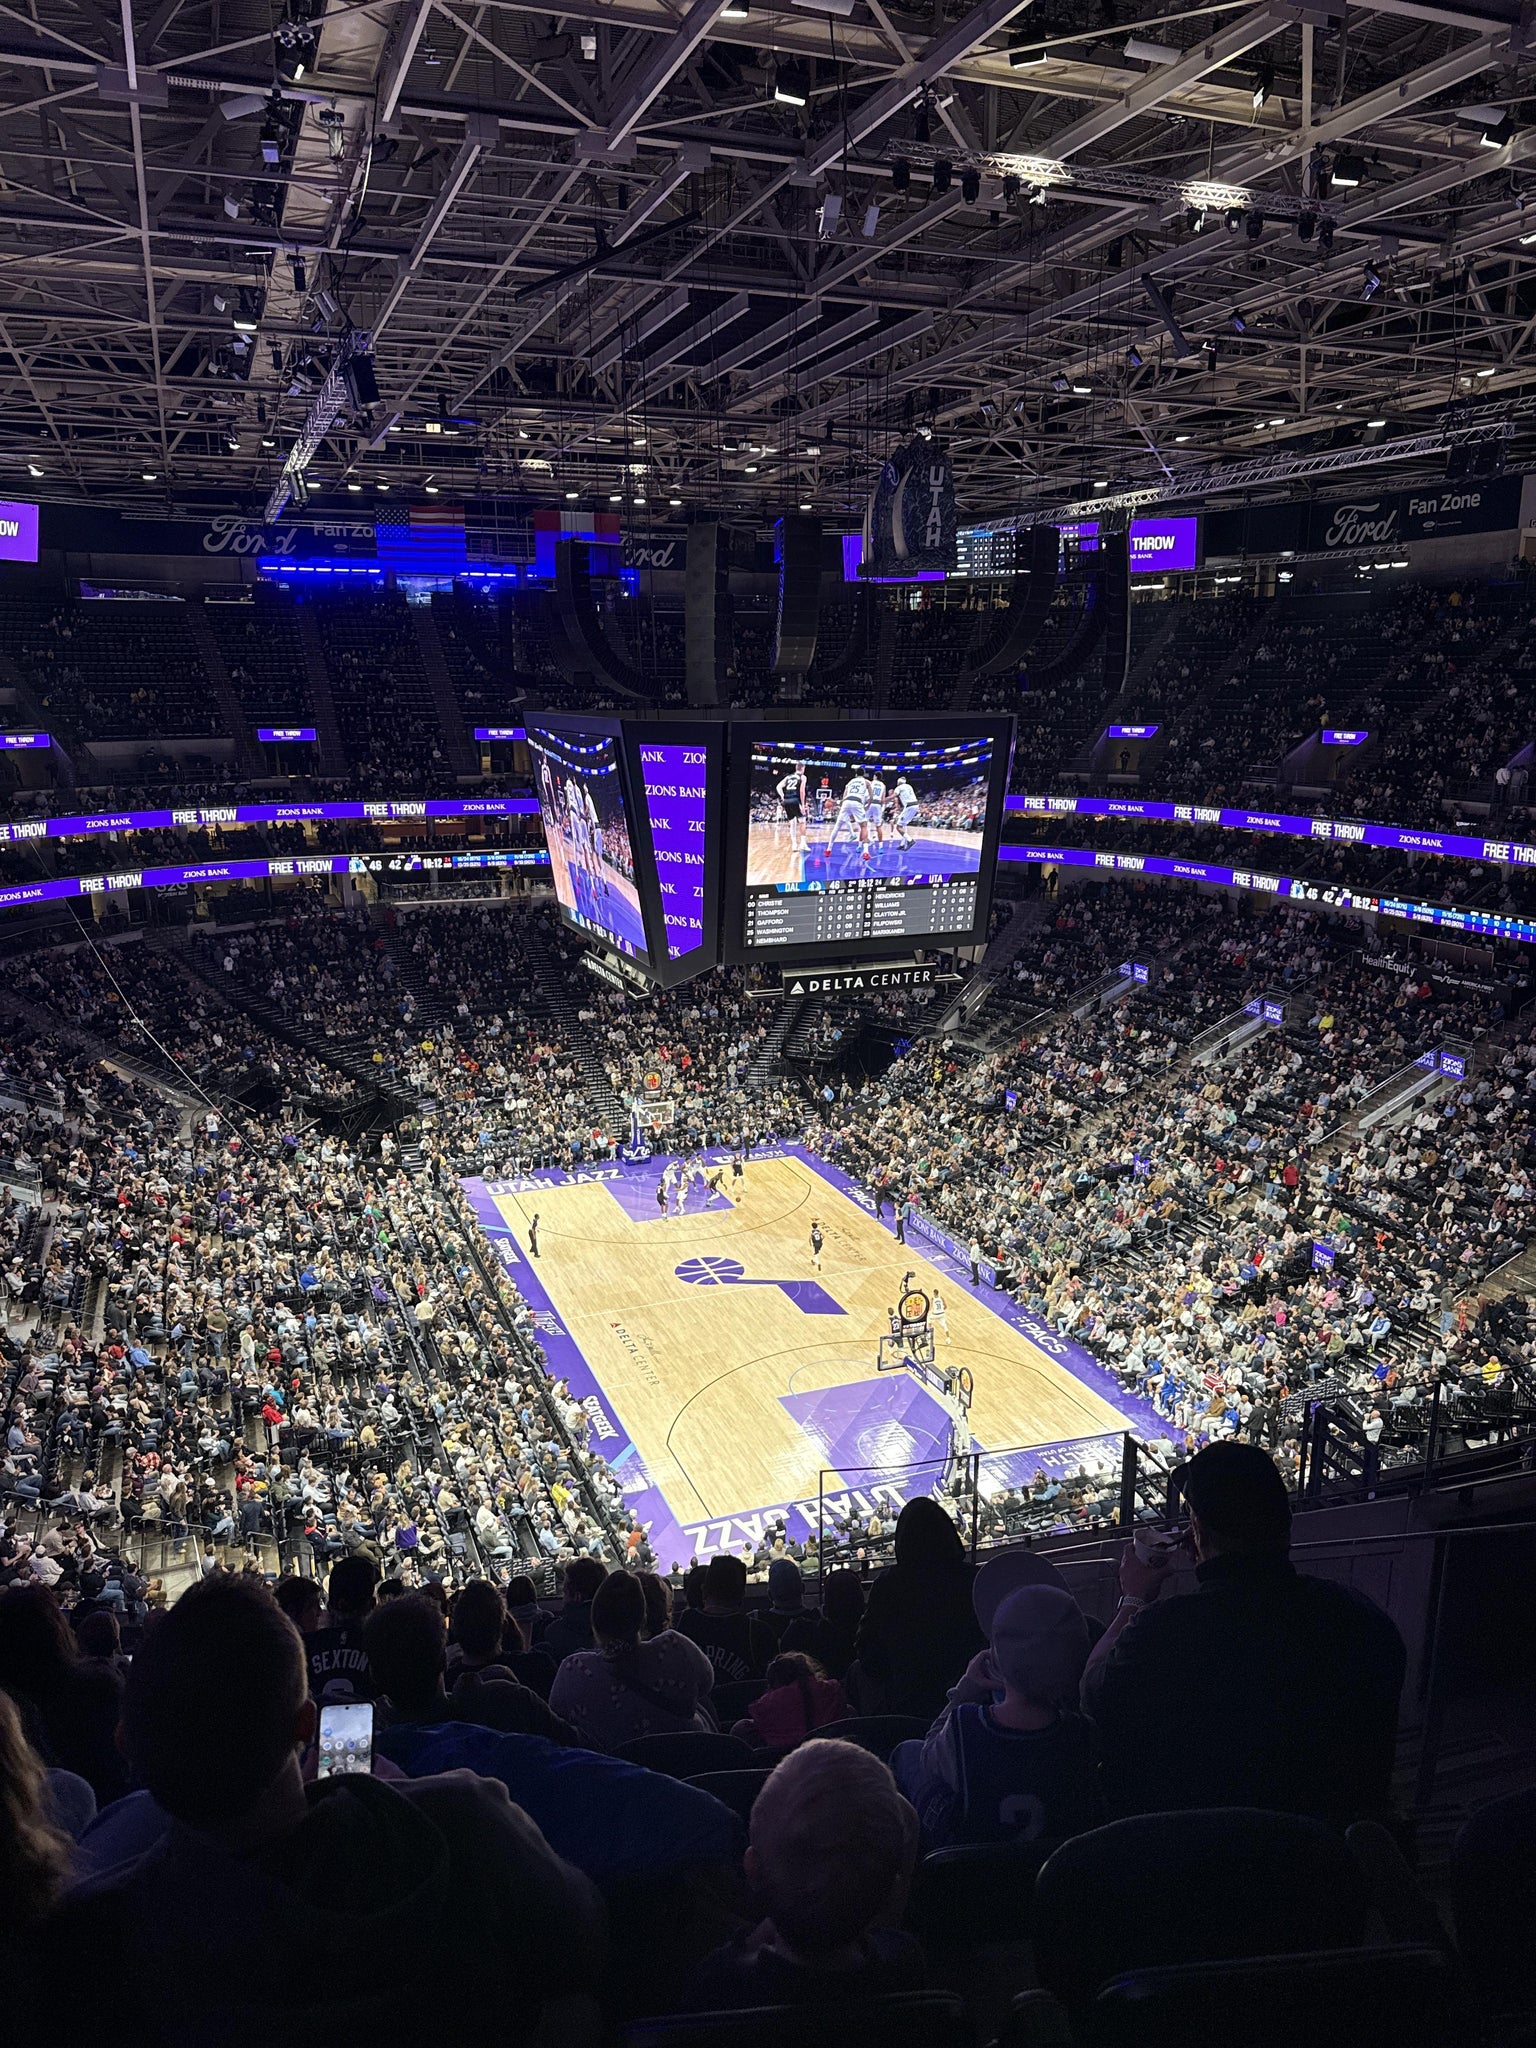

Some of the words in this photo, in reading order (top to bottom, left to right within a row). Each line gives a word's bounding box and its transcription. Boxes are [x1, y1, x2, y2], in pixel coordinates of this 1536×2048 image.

[925, 465, 945, 547] UTAH
[1408, 499, 1437, 516] Fan
[1440, 492, 1481, 511] Zone
[313, 523, 347, 537] Fan
[1325, 502, 1398, 546] Ford
[203, 514, 298, 554] Ford
[1132, 535, 1175, 551] THROW
[644, 784, 677, 797] ZIONS
[786, 779, 798, 790] 22
[12, 822, 47, 838] THROW
[86, 819, 109, 829] ZIONS
[110, 818, 132, 827] BANK
[172, 811, 198, 824] FREE
[200, 809, 237, 822] THROW
[276, 808, 300, 816] ZIONS
[363, 803, 388, 816] FREE
[390, 802, 426, 815] THROW
[463, 803, 485, 811] ZIONS
[486, 802, 506, 810] BANK
[1024, 798, 1046, 809] FREE
[1048, 799, 1078, 811] THROW
[1108, 803, 1126, 811] ZIONS
[1127, 804, 1144, 813] BANK
[1174, 806, 1193, 819] FREE
[1194, 809, 1221, 822] THROW
[1246, 816, 1264, 825] ZIONS
[1264, 818, 1281, 828] BANK
[1311, 821, 1332, 837] FREE
[1333, 824, 1366, 841] THROW
[1399, 834, 1421, 845] ZIONS
[1421, 836, 1443, 848] BANK
[1483, 843, 1509, 860] FREE
[368, 860, 383, 871] 46
[388, 859, 402, 870] 42
[1026, 851, 1046, 859] ZIONS
[1047, 852, 1064, 860] BANK
[1095, 854, 1115, 867] FREE
[1116, 856, 1145, 870] THROW
[1173, 865, 1190, 874] ZIONS
[1190, 867, 1207, 876] BANK
[1232, 872, 1251, 886] FREE
[1252, 875, 1280, 892] THROW
[0, 892, 21, 901] ZIONS
[22, 889, 43, 899] BANK
[80, 878, 105, 893] FREE
[106, 874, 143, 890] THROW
[183, 870, 206, 879] ZIONS
[207, 868, 230, 876] BANK
[268, 861, 294, 875] FREE
[295, 860, 333, 873] THROW
[829, 880, 841, 890] 46
[874, 878, 882, 886] 24
[889, 877, 901, 886] 42
[928, 874, 943, 884] UTA
[784, 883, 800, 892] DAL
[1306, 887, 1318, 900] 46
[1322, 890, 1334, 903] 42
[874, 901, 900, 909] WILLIAMS
[756, 918, 784, 926] GAFFORD
[756, 927, 794, 935] WASHINGTON
[1362, 953, 1417, 977] HealthEquity
[808, 976, 865, 992] DELTA
[870, 970, 931, 987] CENTER
[1481, 984, 1495, 992] FIRST
[1442, 1063, 1463, 1076] BANK
[485, 1177, 555, 1195] UTAH
[559, 1168, 625, 1186] JAZZ
[912, 1215, 931, 1236] ZIONS
[930, 1229, 947, 1249] BANK
[952, 1246, 972, 1271] ZIONS
[1019, 1317, 1068, 1354] PACS
[615, 1328, 639, 1354] DELTA
[633, 1355, 660, 1386] CENTER
[582, 1394, 620, 1441] SEATGEEK
[683, 1507, 791, 1556] JAZZ
[311, 1648, 369, 1675] SEXTON
